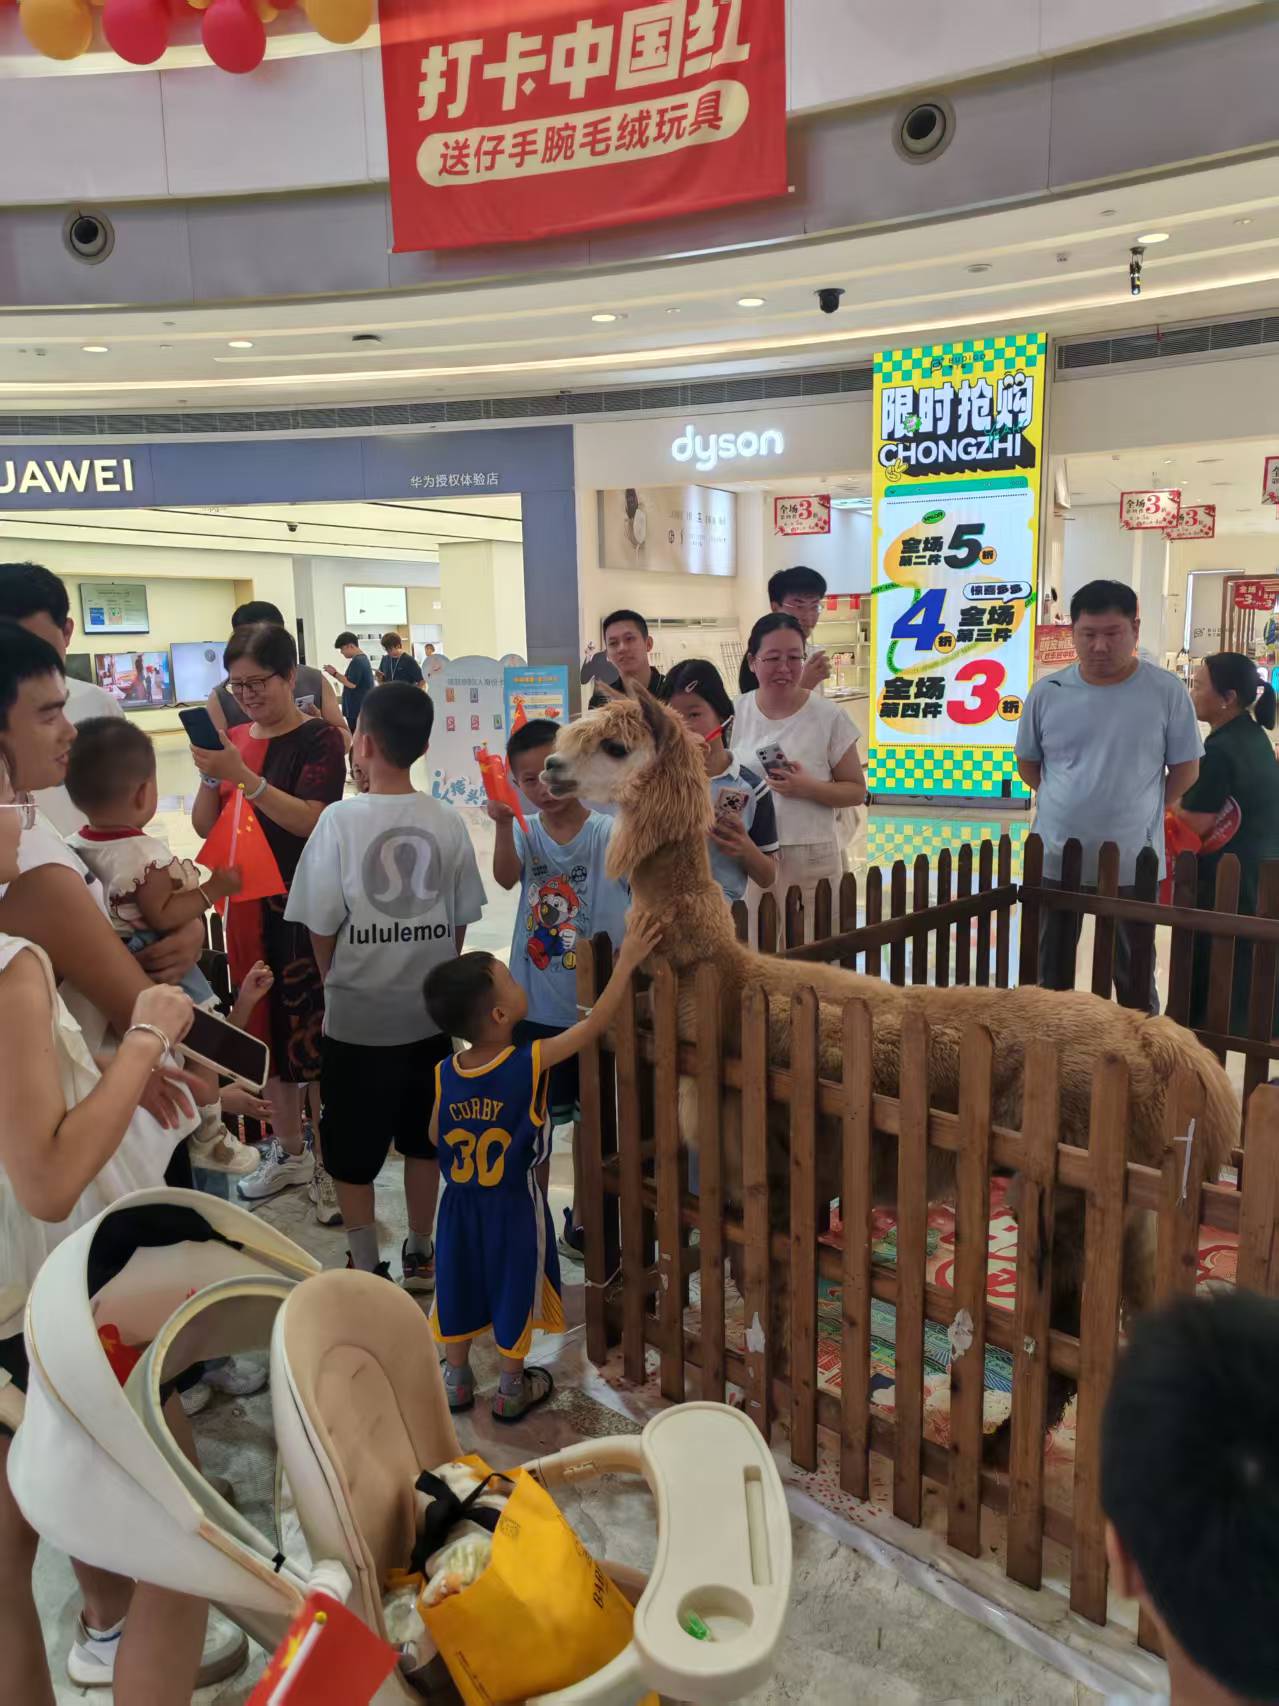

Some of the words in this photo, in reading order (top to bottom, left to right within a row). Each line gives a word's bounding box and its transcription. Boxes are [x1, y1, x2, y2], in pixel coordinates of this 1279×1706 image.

[417, 0, 750, 121] 打卡中国红
[438, 90, 724, 177] 送仔手腕毛绒玩具
[881, 376, 1035, 440] 限时抢购
[671, 424, 785, 471] dyson
[879, 433, 1021, 468] CHONGZHI
[410, 471, 500, 489] 华为授权体验店
[798, 499, 813, 520] 3
[1145, 494, 1161, 515] 3
[1184, 509, 1198, 527] 3
[943, 523, 985, 569] 5
[890, 588, 947, 652] 4
[958, 605, 1015, 627] 全场
[956, 628, 1013, 643] 第三件
[882, 676, 946, 700] 全场
[946, 659, 1007, 725] 3
[879, 702, 943, 719] 第四件
[443, 1127, 512, 1187] 30
